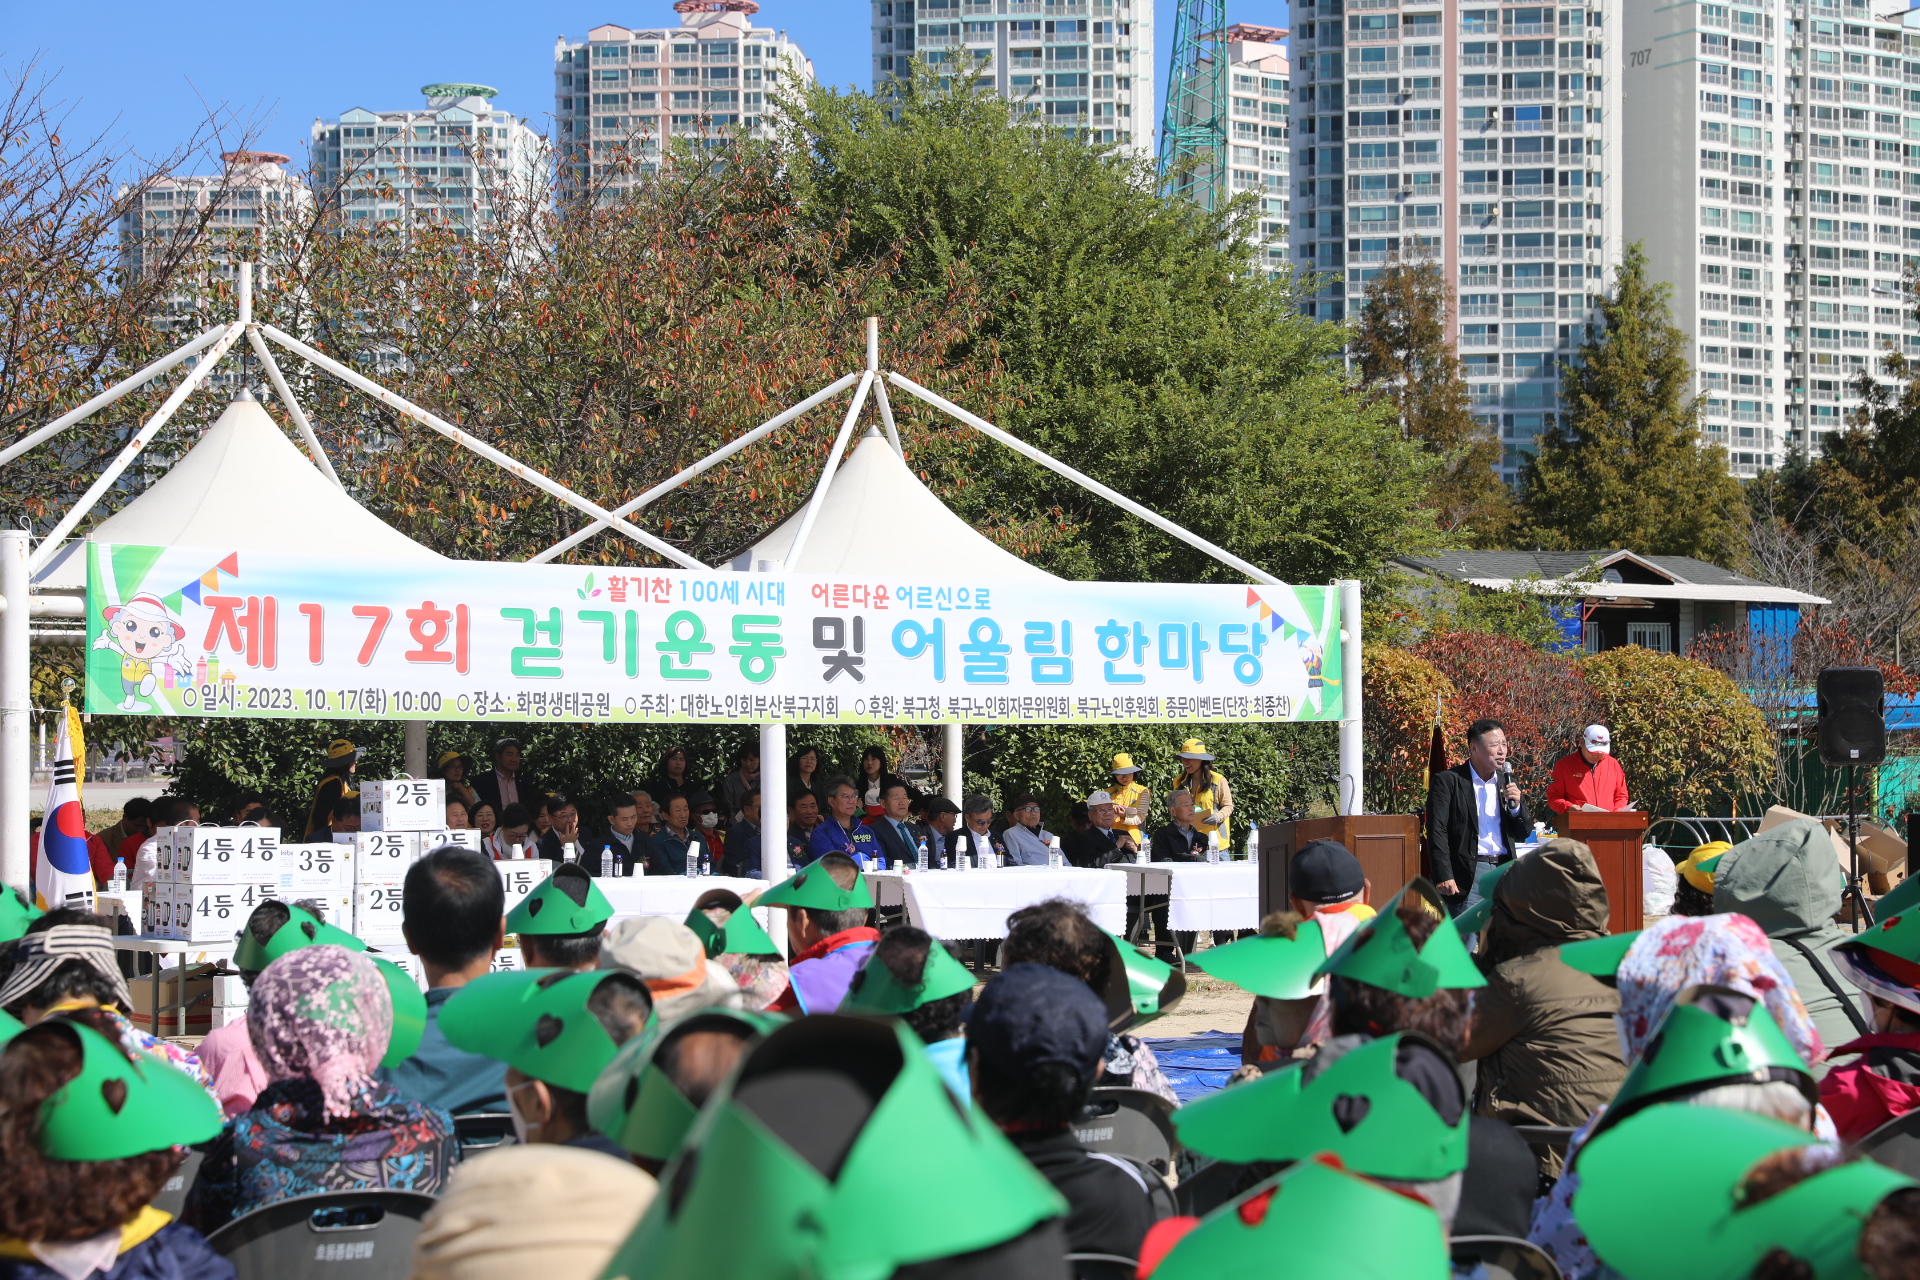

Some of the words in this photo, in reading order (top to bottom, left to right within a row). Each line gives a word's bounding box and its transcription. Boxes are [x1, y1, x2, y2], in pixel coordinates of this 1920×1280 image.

[1630, 48, 1652, 67] 707
[609, 575, 672, 604] 활기찬
[679, 579, 739, 606] 100세
[746, 580, 785, 606] 시대
[812, 583, 889, 610] 어른다운
[896, 585, 991, 612] 어르신으로
[202, 595, 470, 674] 제17회
[501, 605, 786, 684] 걷기운동
[812, 615, 865, 682] 및
[891, 616, 1073, 685] 어울림
[1095, 617, 1268, 686] 한마당
[247, 687, 299, 711] 2023.
[305, 688, 332, 711] 10.
[338, 687, 387, 715] 17(화)
[393, 690, 443, 712] 10:00
[516, 691, 611, 718] 화명생태공원
[680, 693, 839, 719] 대한노인회부산북구지회
[396, 783, 431, 806] 2등
[196, 838, 235, 862] 4등
[240, 837, 278, 861] 4등
[370, 835, 405, 858] 2등
[299, 850, 335, 873] 3등
[504, 871, 532, 894] 1등
[196, 894, 235, 919] 4등
[240, 885, 278, 906] 4등
[370, 888, 403, 912] 2등
